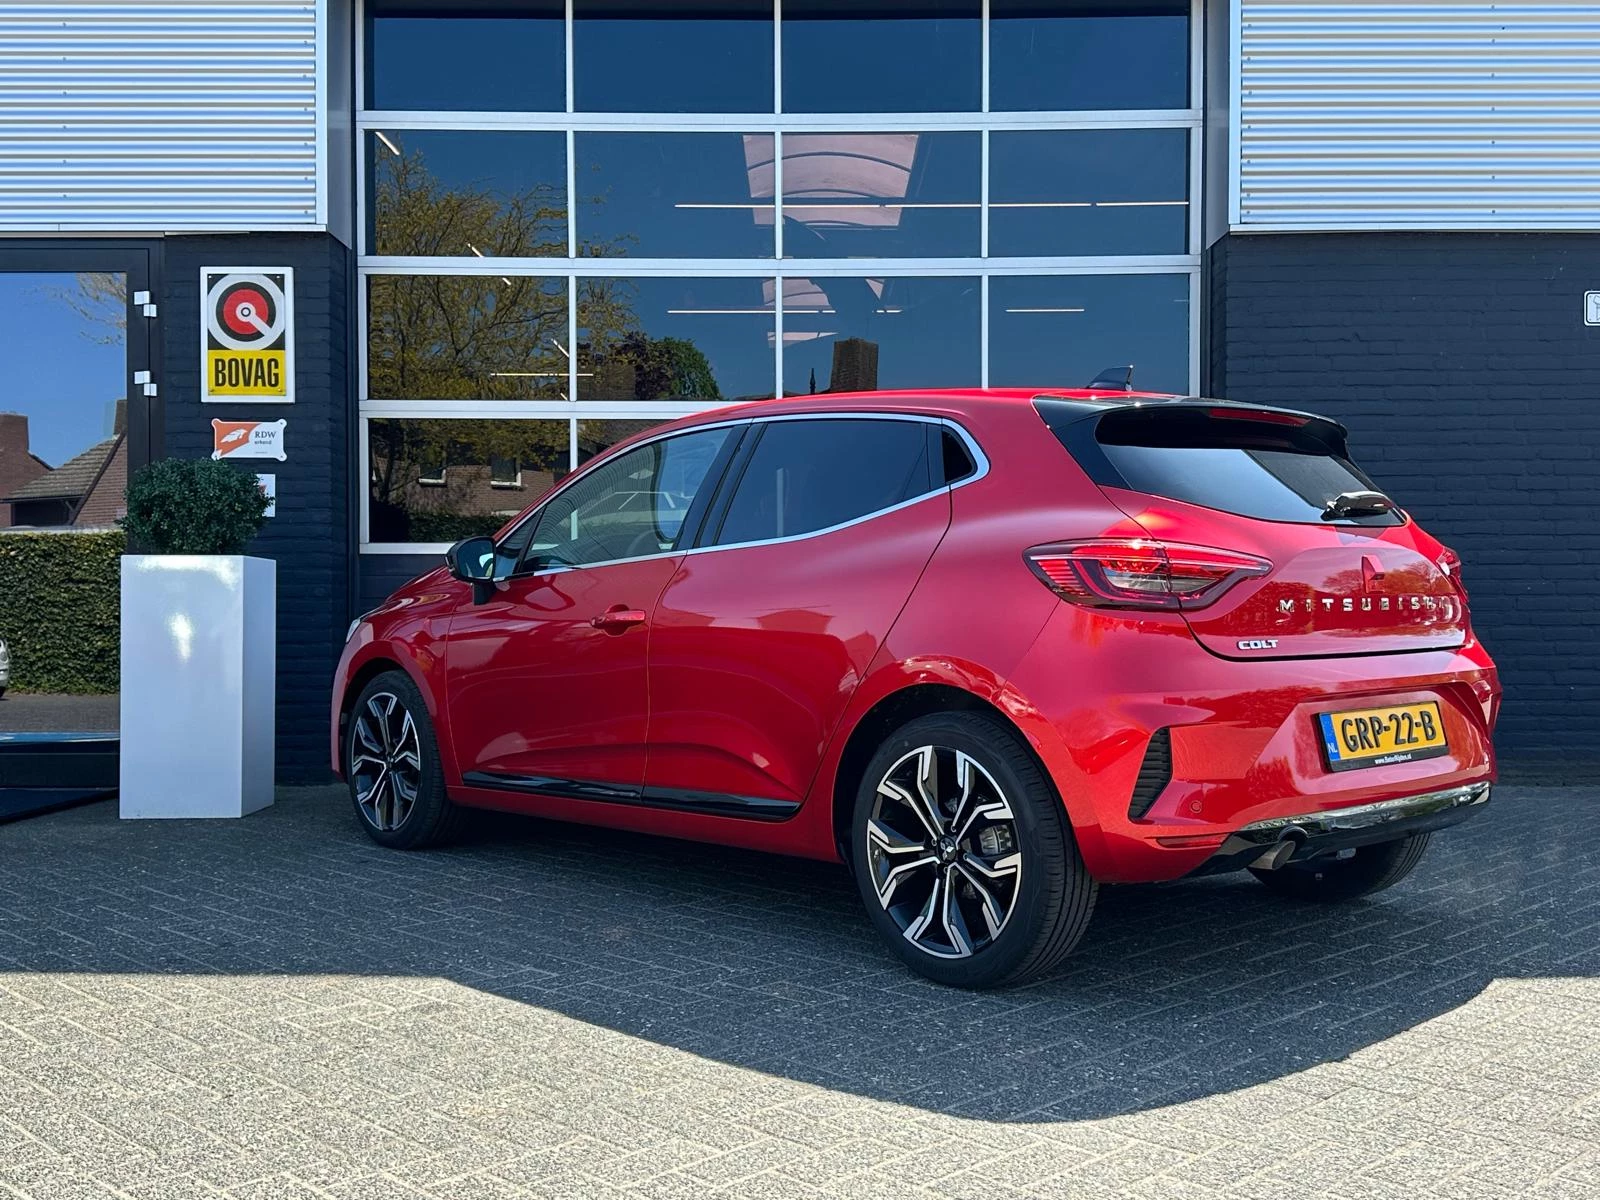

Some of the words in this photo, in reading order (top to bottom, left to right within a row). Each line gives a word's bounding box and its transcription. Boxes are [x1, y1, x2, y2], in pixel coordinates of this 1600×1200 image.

[214, 357, 279, 388] BOVAG
[1237, 639, 1279, 650] COLT
[1327, 742, 1338, 753] NL
[1341, 710, 1437, 752] GRP-22-B
